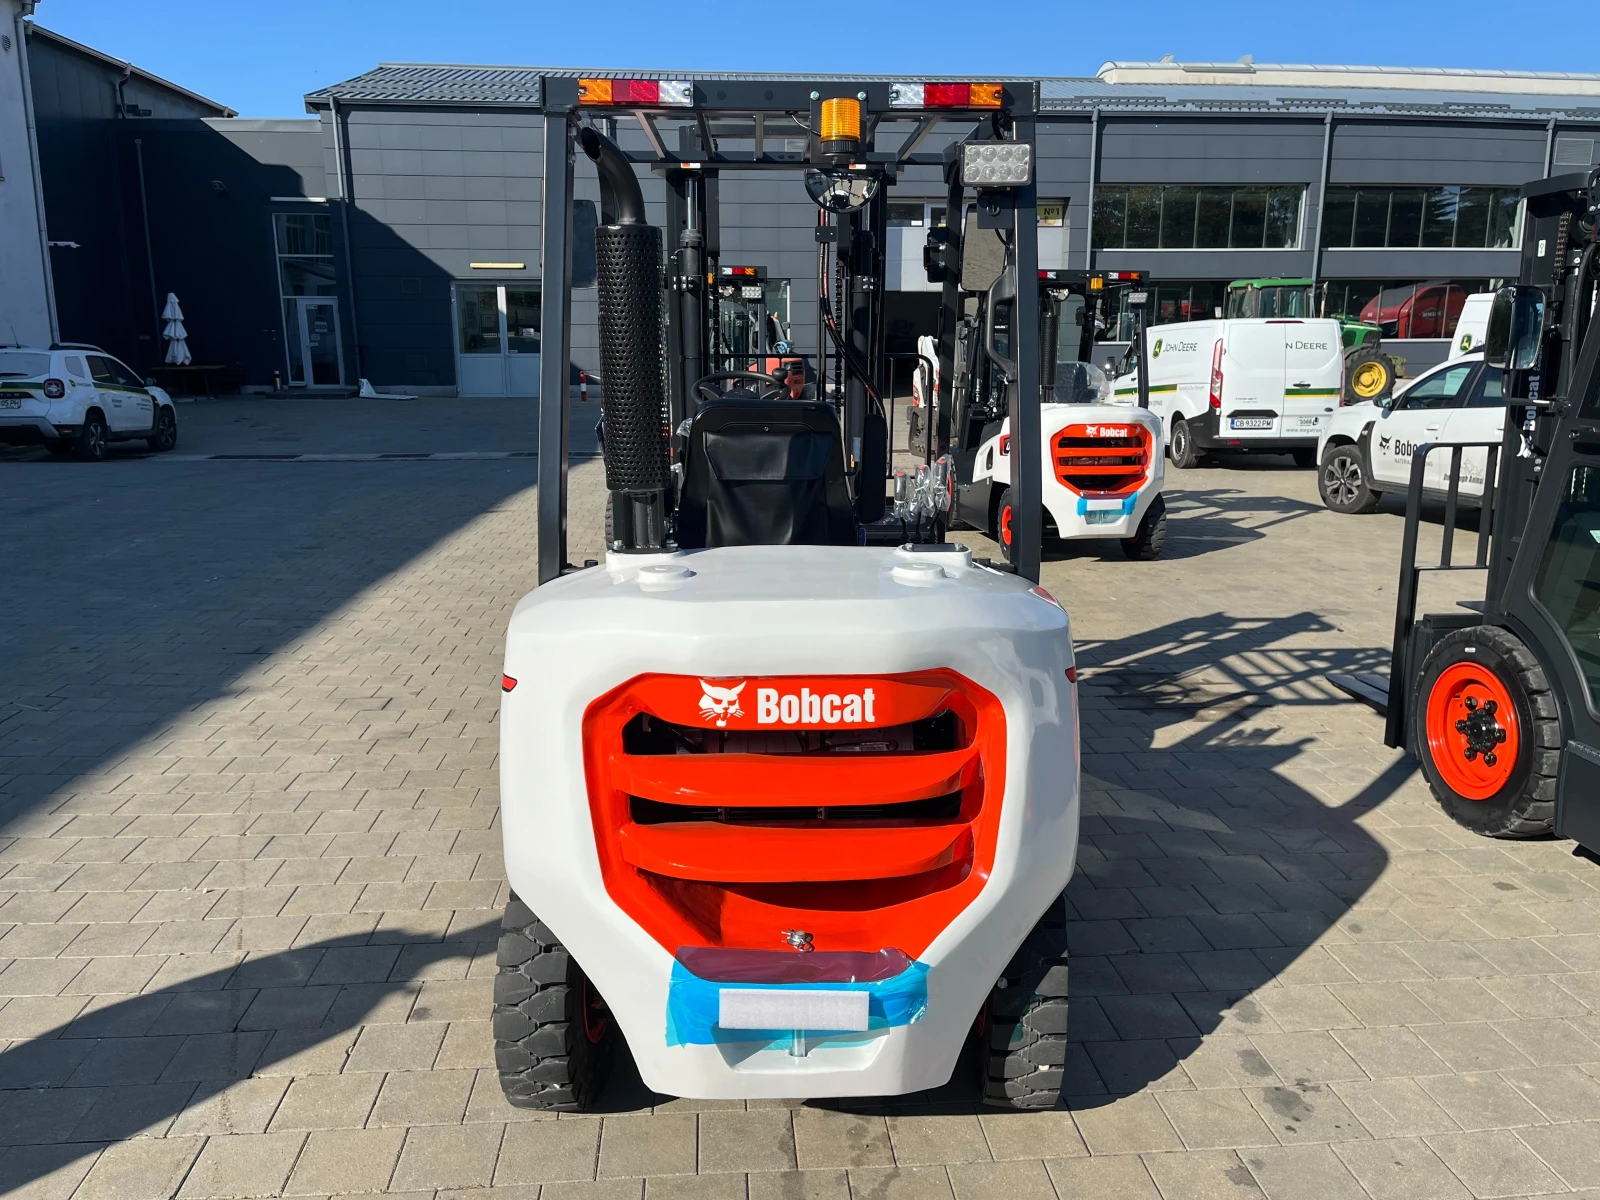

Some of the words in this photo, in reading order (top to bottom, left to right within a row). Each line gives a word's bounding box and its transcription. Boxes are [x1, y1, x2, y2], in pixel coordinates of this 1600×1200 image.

[1163, 342, 1178, 353] JOHN
[1178, 341, 1198, 352] DEERE
[1295, 341, 1328, 350] DEERE
[1235, 419, 1245, 427] CB
[1245, 419, 1262, 427] 9322
[1262, 419, 1272, 427] PM
[1100, 427, 1128, 437] Bobcat
[757, 688, 876, 724] Bobcat
